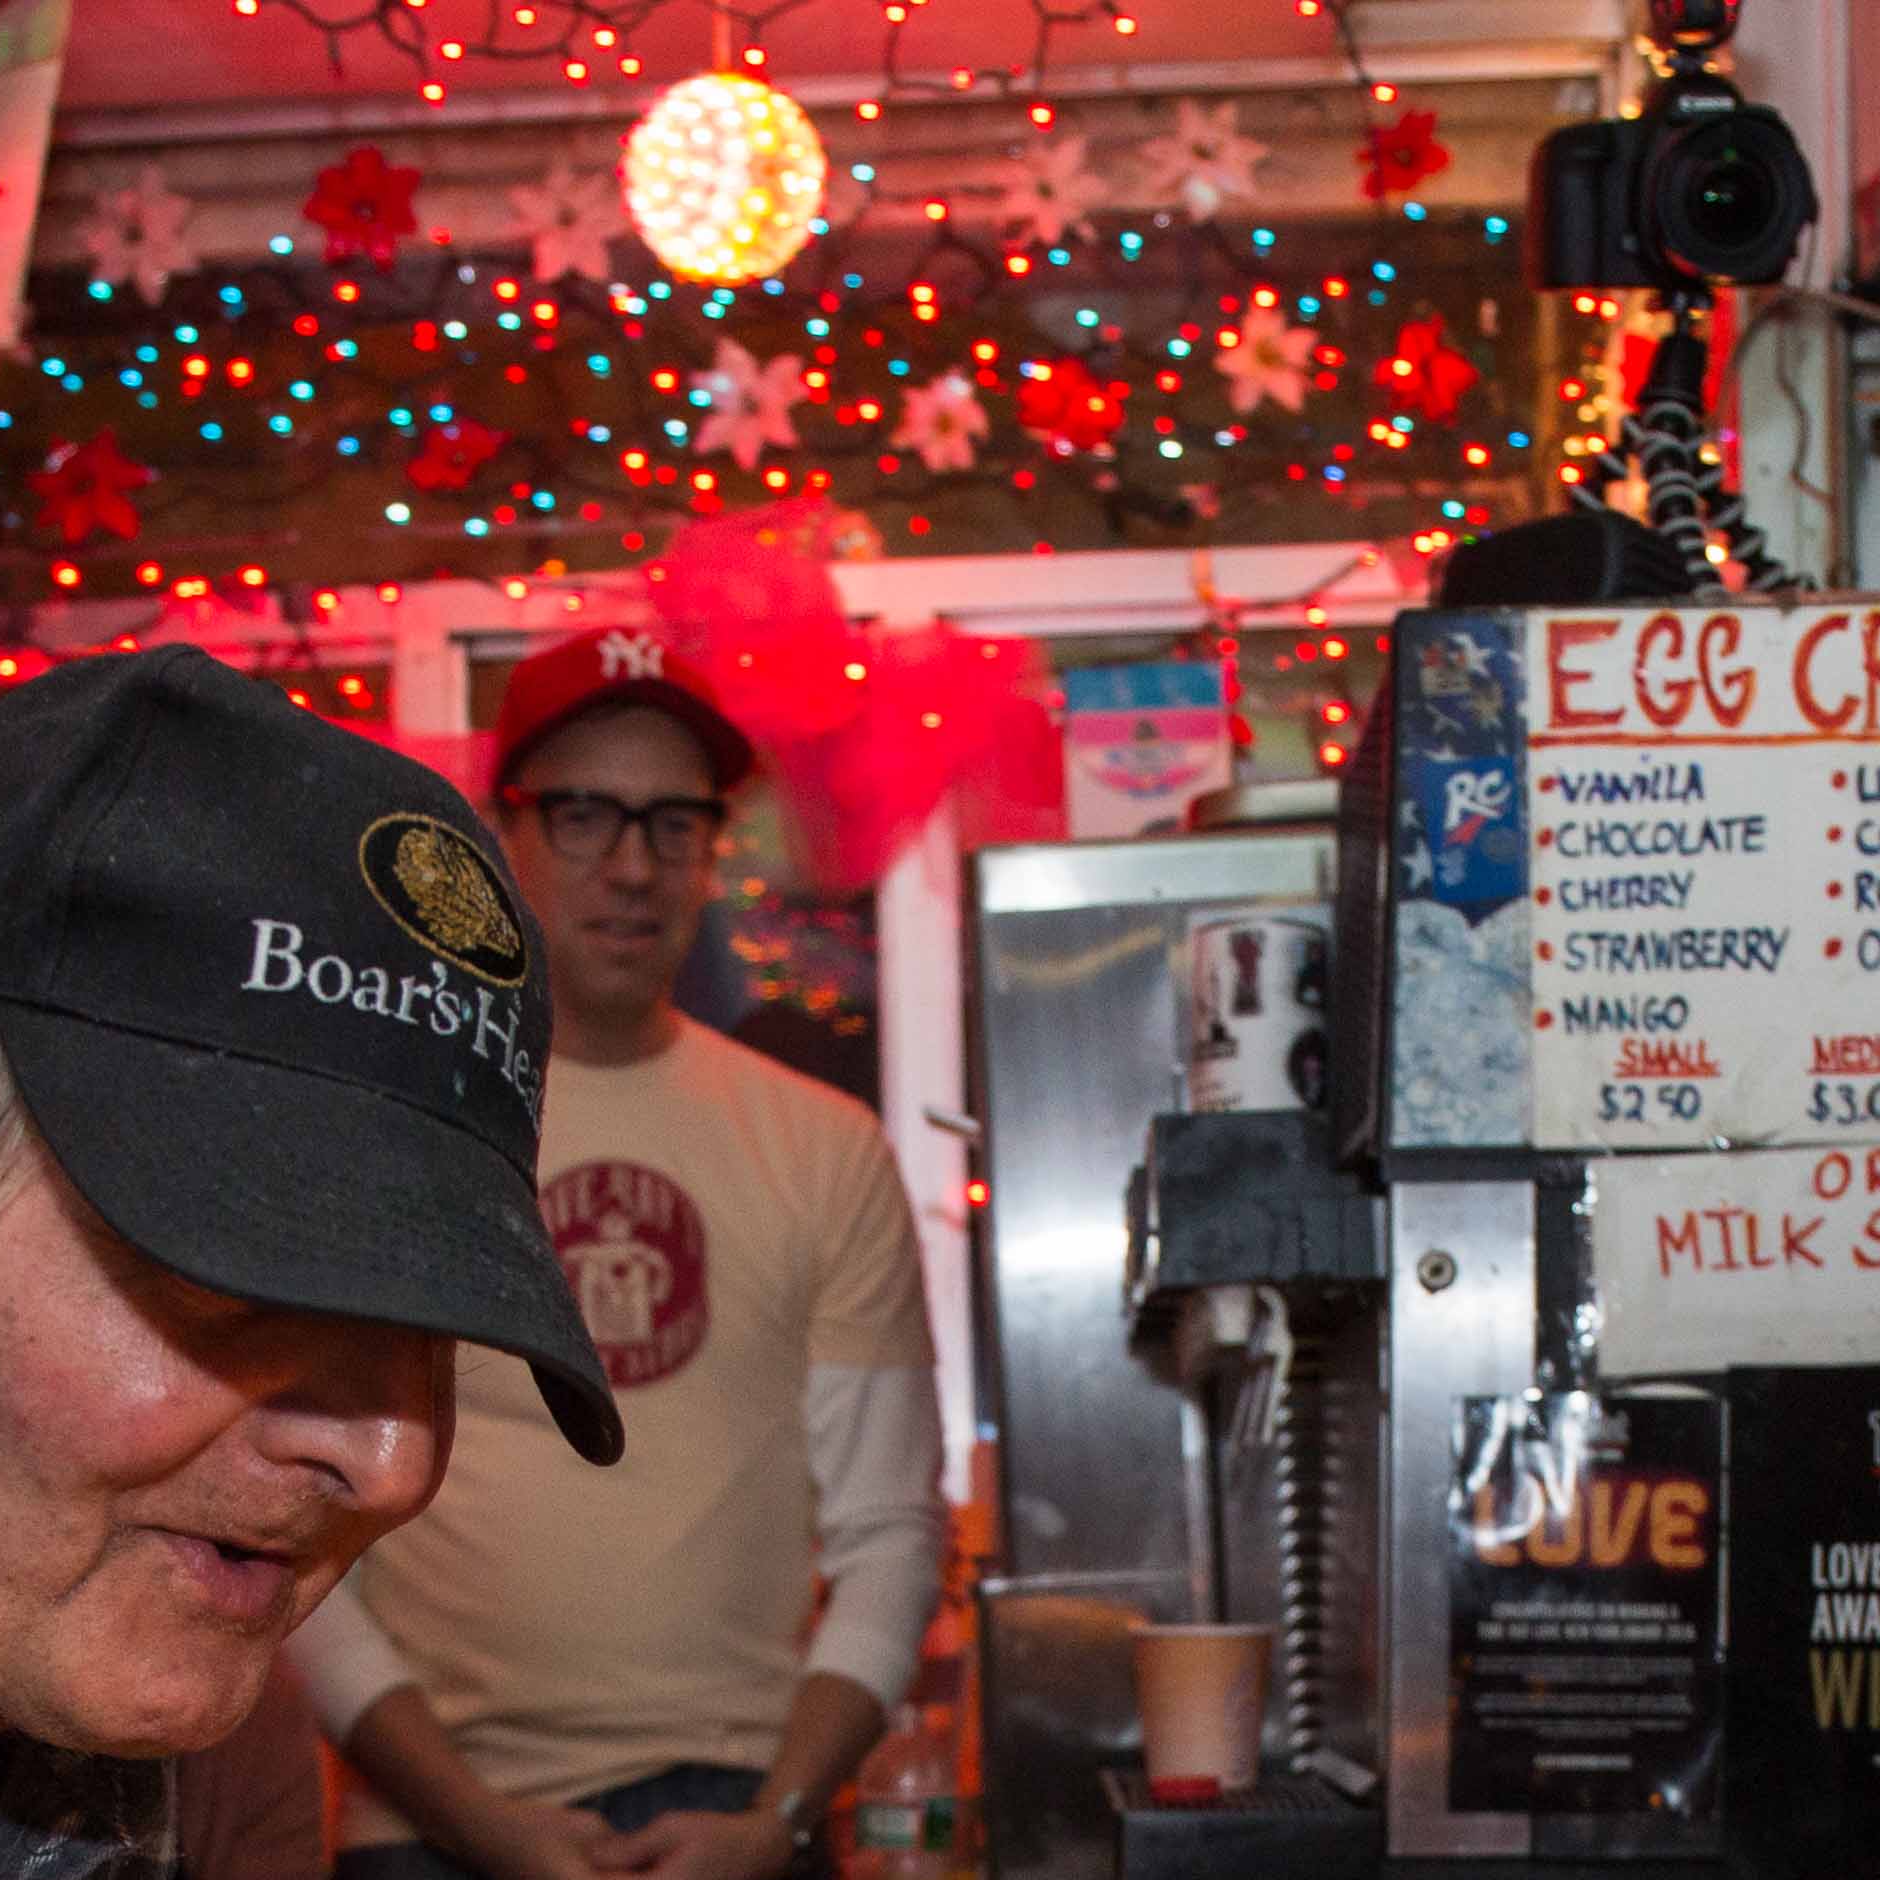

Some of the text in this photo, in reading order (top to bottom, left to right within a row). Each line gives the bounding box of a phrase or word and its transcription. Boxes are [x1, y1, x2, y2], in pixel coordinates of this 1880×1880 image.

[1545, 609, 1758, 729] EGG
[1443, 769, 1512, 831] RC
[1557, 815, 1768, 858] CHOCOLATE
[1558, 869, 1695, 912] CHERRY
[241, 917, 462, 1035] Boar's
[1564, 925, 1791, 973] STRAWBERRY
[1562, 994, 1690, 1036] MANGO
[1620, 1036, 1712, 1071] SMALL
[1655, 1200, 1826, 1278] MILK
[1473, 1481, 1710, 1570] LOVE
